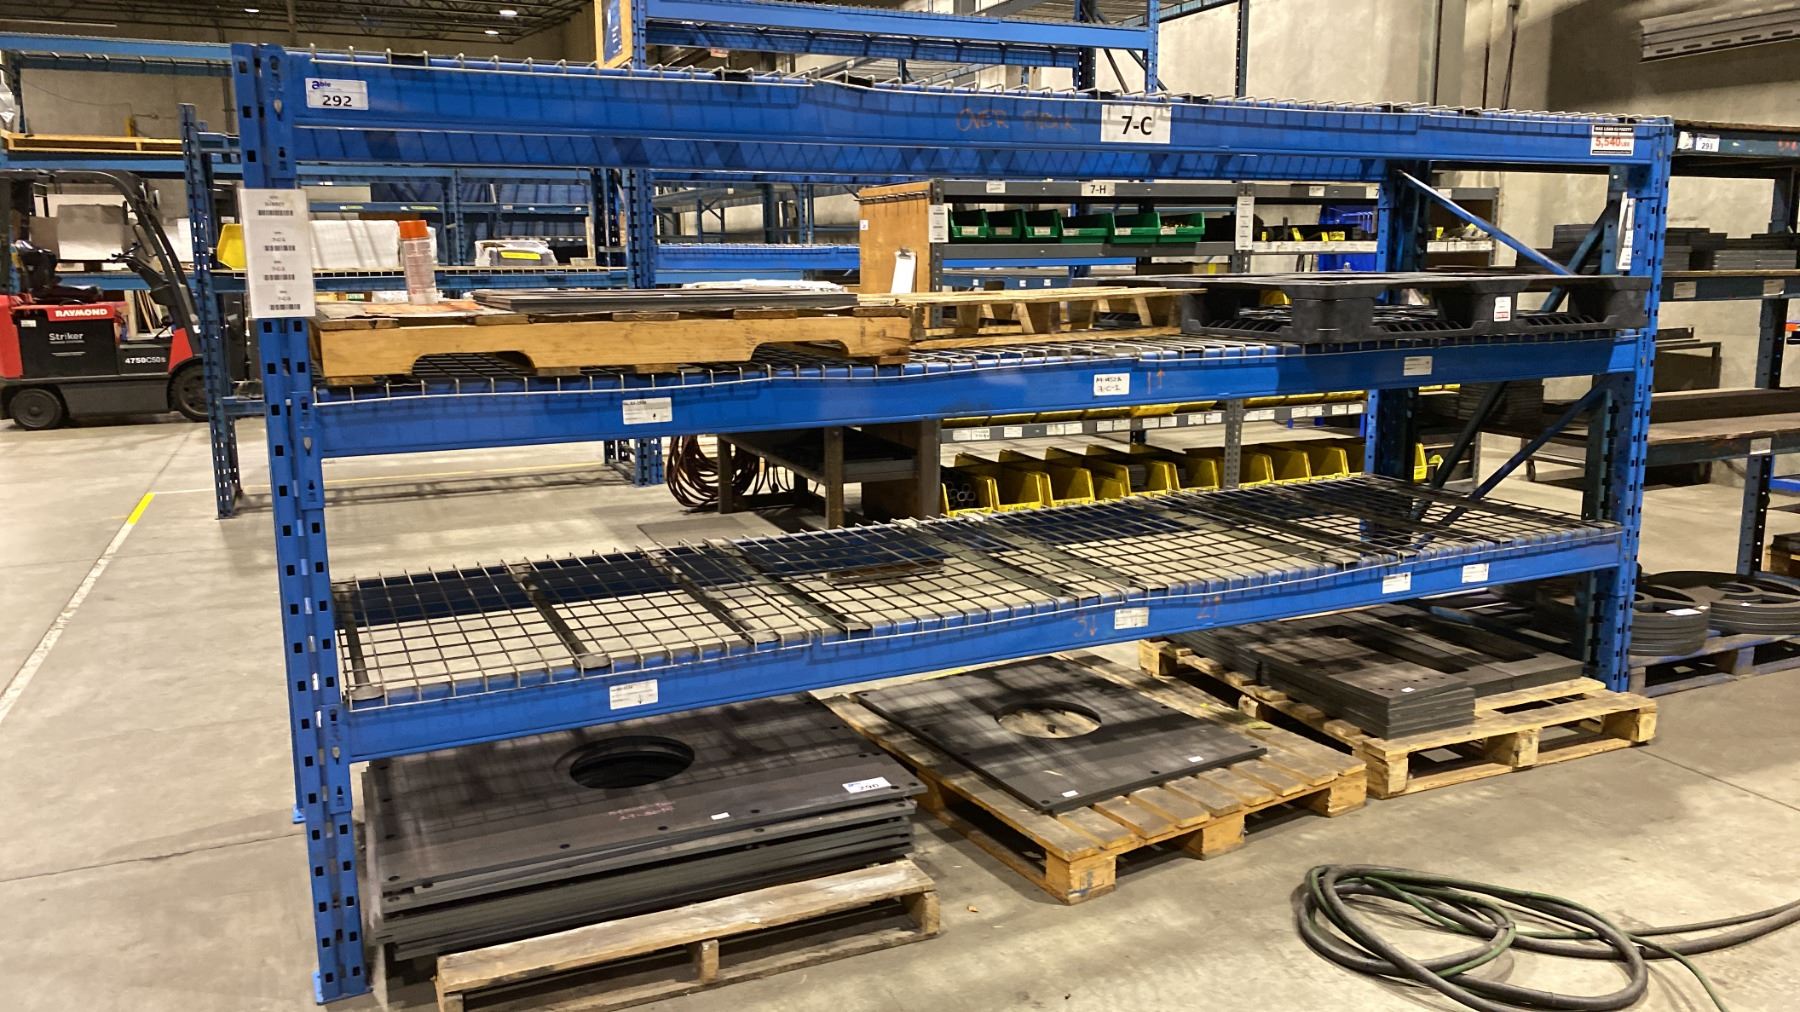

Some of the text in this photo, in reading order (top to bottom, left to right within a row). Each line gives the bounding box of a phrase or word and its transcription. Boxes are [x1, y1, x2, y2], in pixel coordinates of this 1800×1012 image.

[322, 94, 353, 107] 292
[1121, 115, 1153, 136] 7-C
[1090, 184, 1107, 194] 7-H
[54, 308, 108, 318] RAYMOND
[49, 332, 84, 340] Striker
